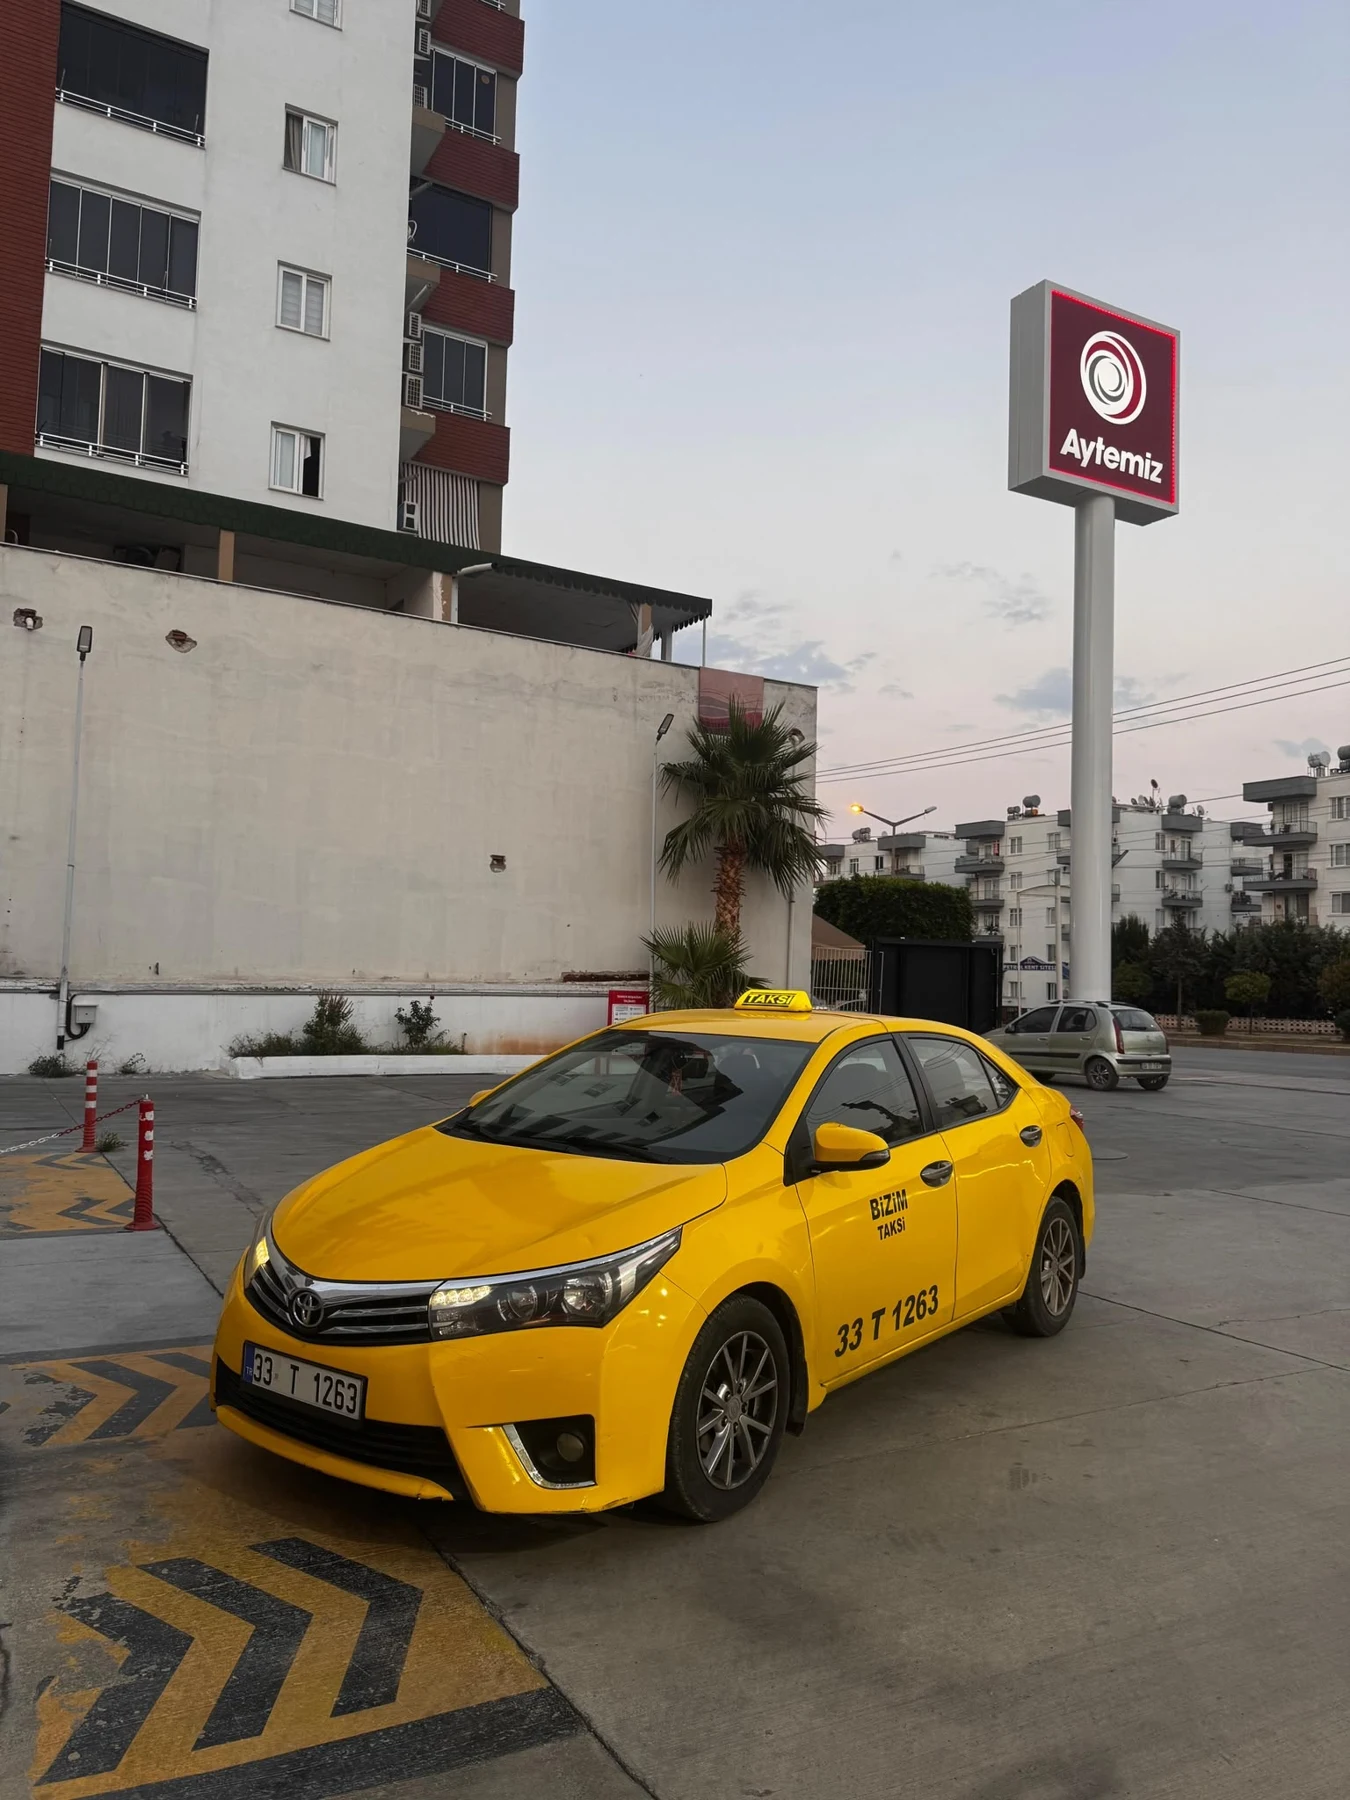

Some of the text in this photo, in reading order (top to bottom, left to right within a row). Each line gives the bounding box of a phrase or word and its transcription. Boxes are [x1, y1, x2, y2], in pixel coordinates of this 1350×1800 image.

[1060, 428, 1164, 484] Aytemiz
[834, 1285, 938, 1357] 33 T 1263
[245, 1366, 253, 1376] TR
[253, 1353, 357, 1414] 33 T 1263
